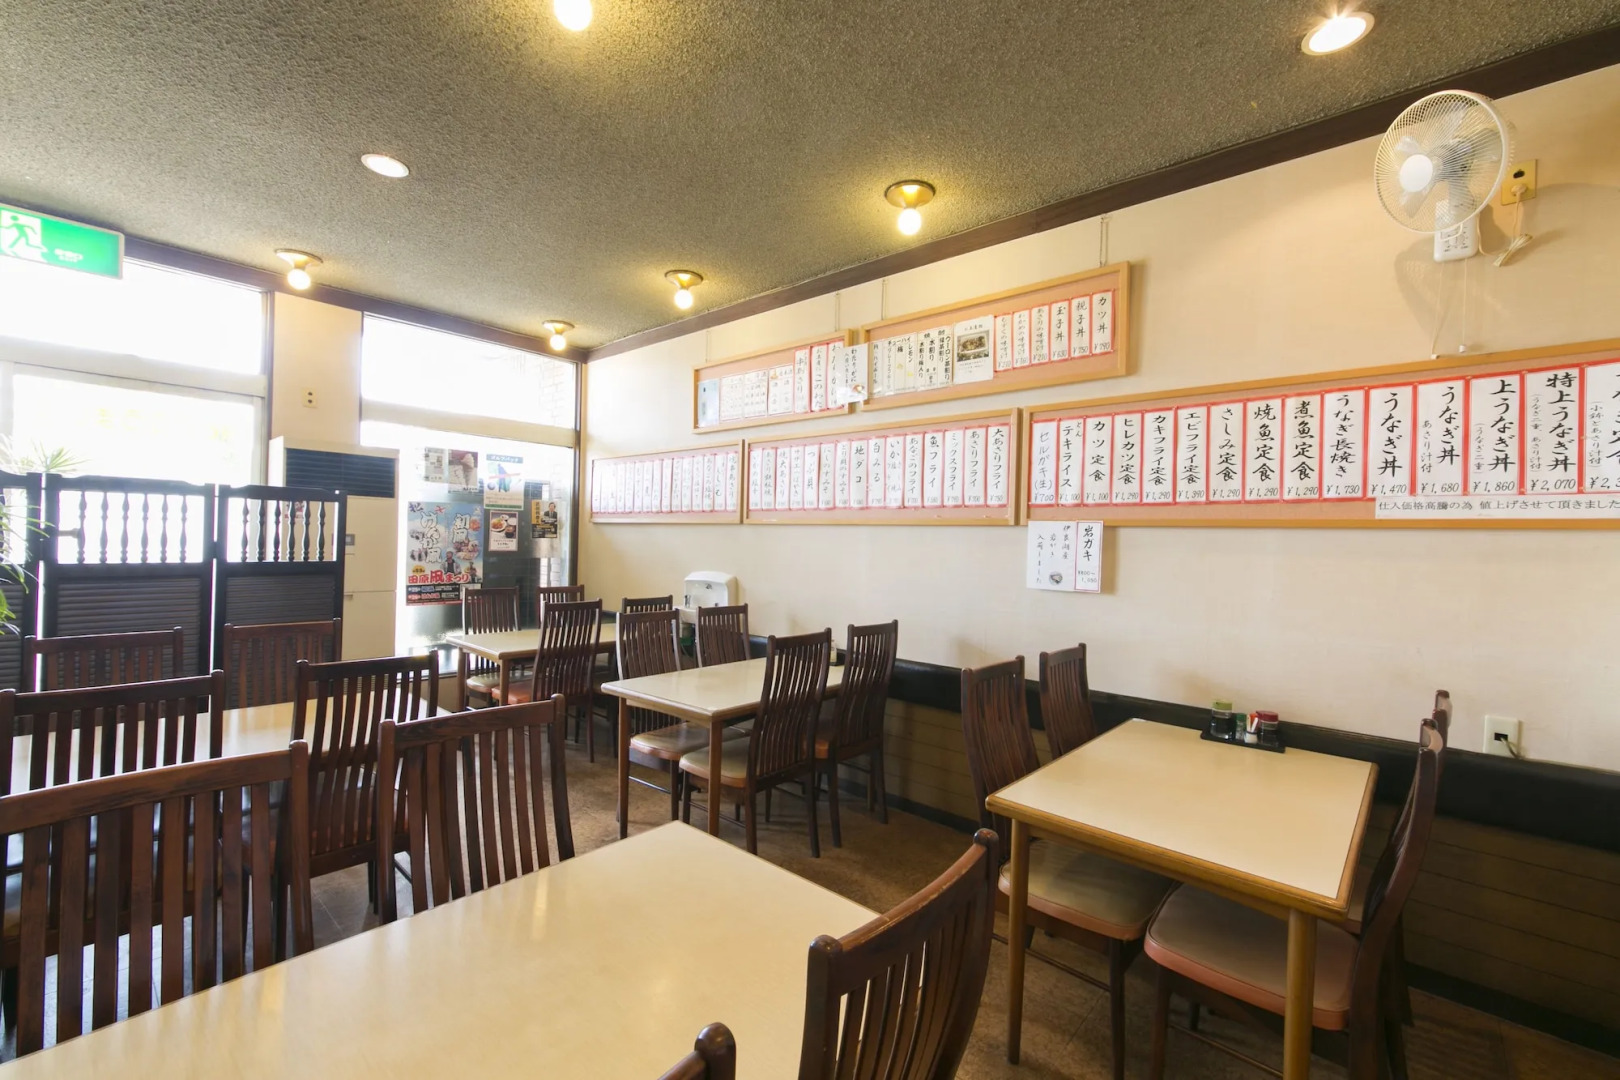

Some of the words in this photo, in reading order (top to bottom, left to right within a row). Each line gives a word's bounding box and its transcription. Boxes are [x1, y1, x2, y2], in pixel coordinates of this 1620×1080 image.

[1055, 305, 1067, 342] 玉子丼
[1075, 300, 1088, 338] 親子丼
[1097, 296, 1108, 334] カツ丼
[1060, 425, 1076, 488] テキライス
[1088, 420, 1107, 483] カツ定食
[1117, 418, 1137, 485] ヒレカツ定食
[1148, 415, 1171, 486] カキフライ定食
[1180, 411, 1201, 485] エビフライ定食
[1215, 407, 1238, 482] さしみ定食
[1252, 403, 1277, 482] 焼魚定食
[1290, 400, 1316, 481] 煮魚定食
[1330, 394, 1357, 478] うなぎ長焼き
[1377, 392, 1404, 478] うなぎ丼
[1436, 385, 1461, 466] うなぎ丼
[1487, 379, 1517, 474] 上うなぎ丼
[1545, 371, 1578, 474] 特上うなぎ丼
[929, 435, 940, 488] 魚フライ
[1378, 501, 1473, 511] 仕入価格高騰の為
